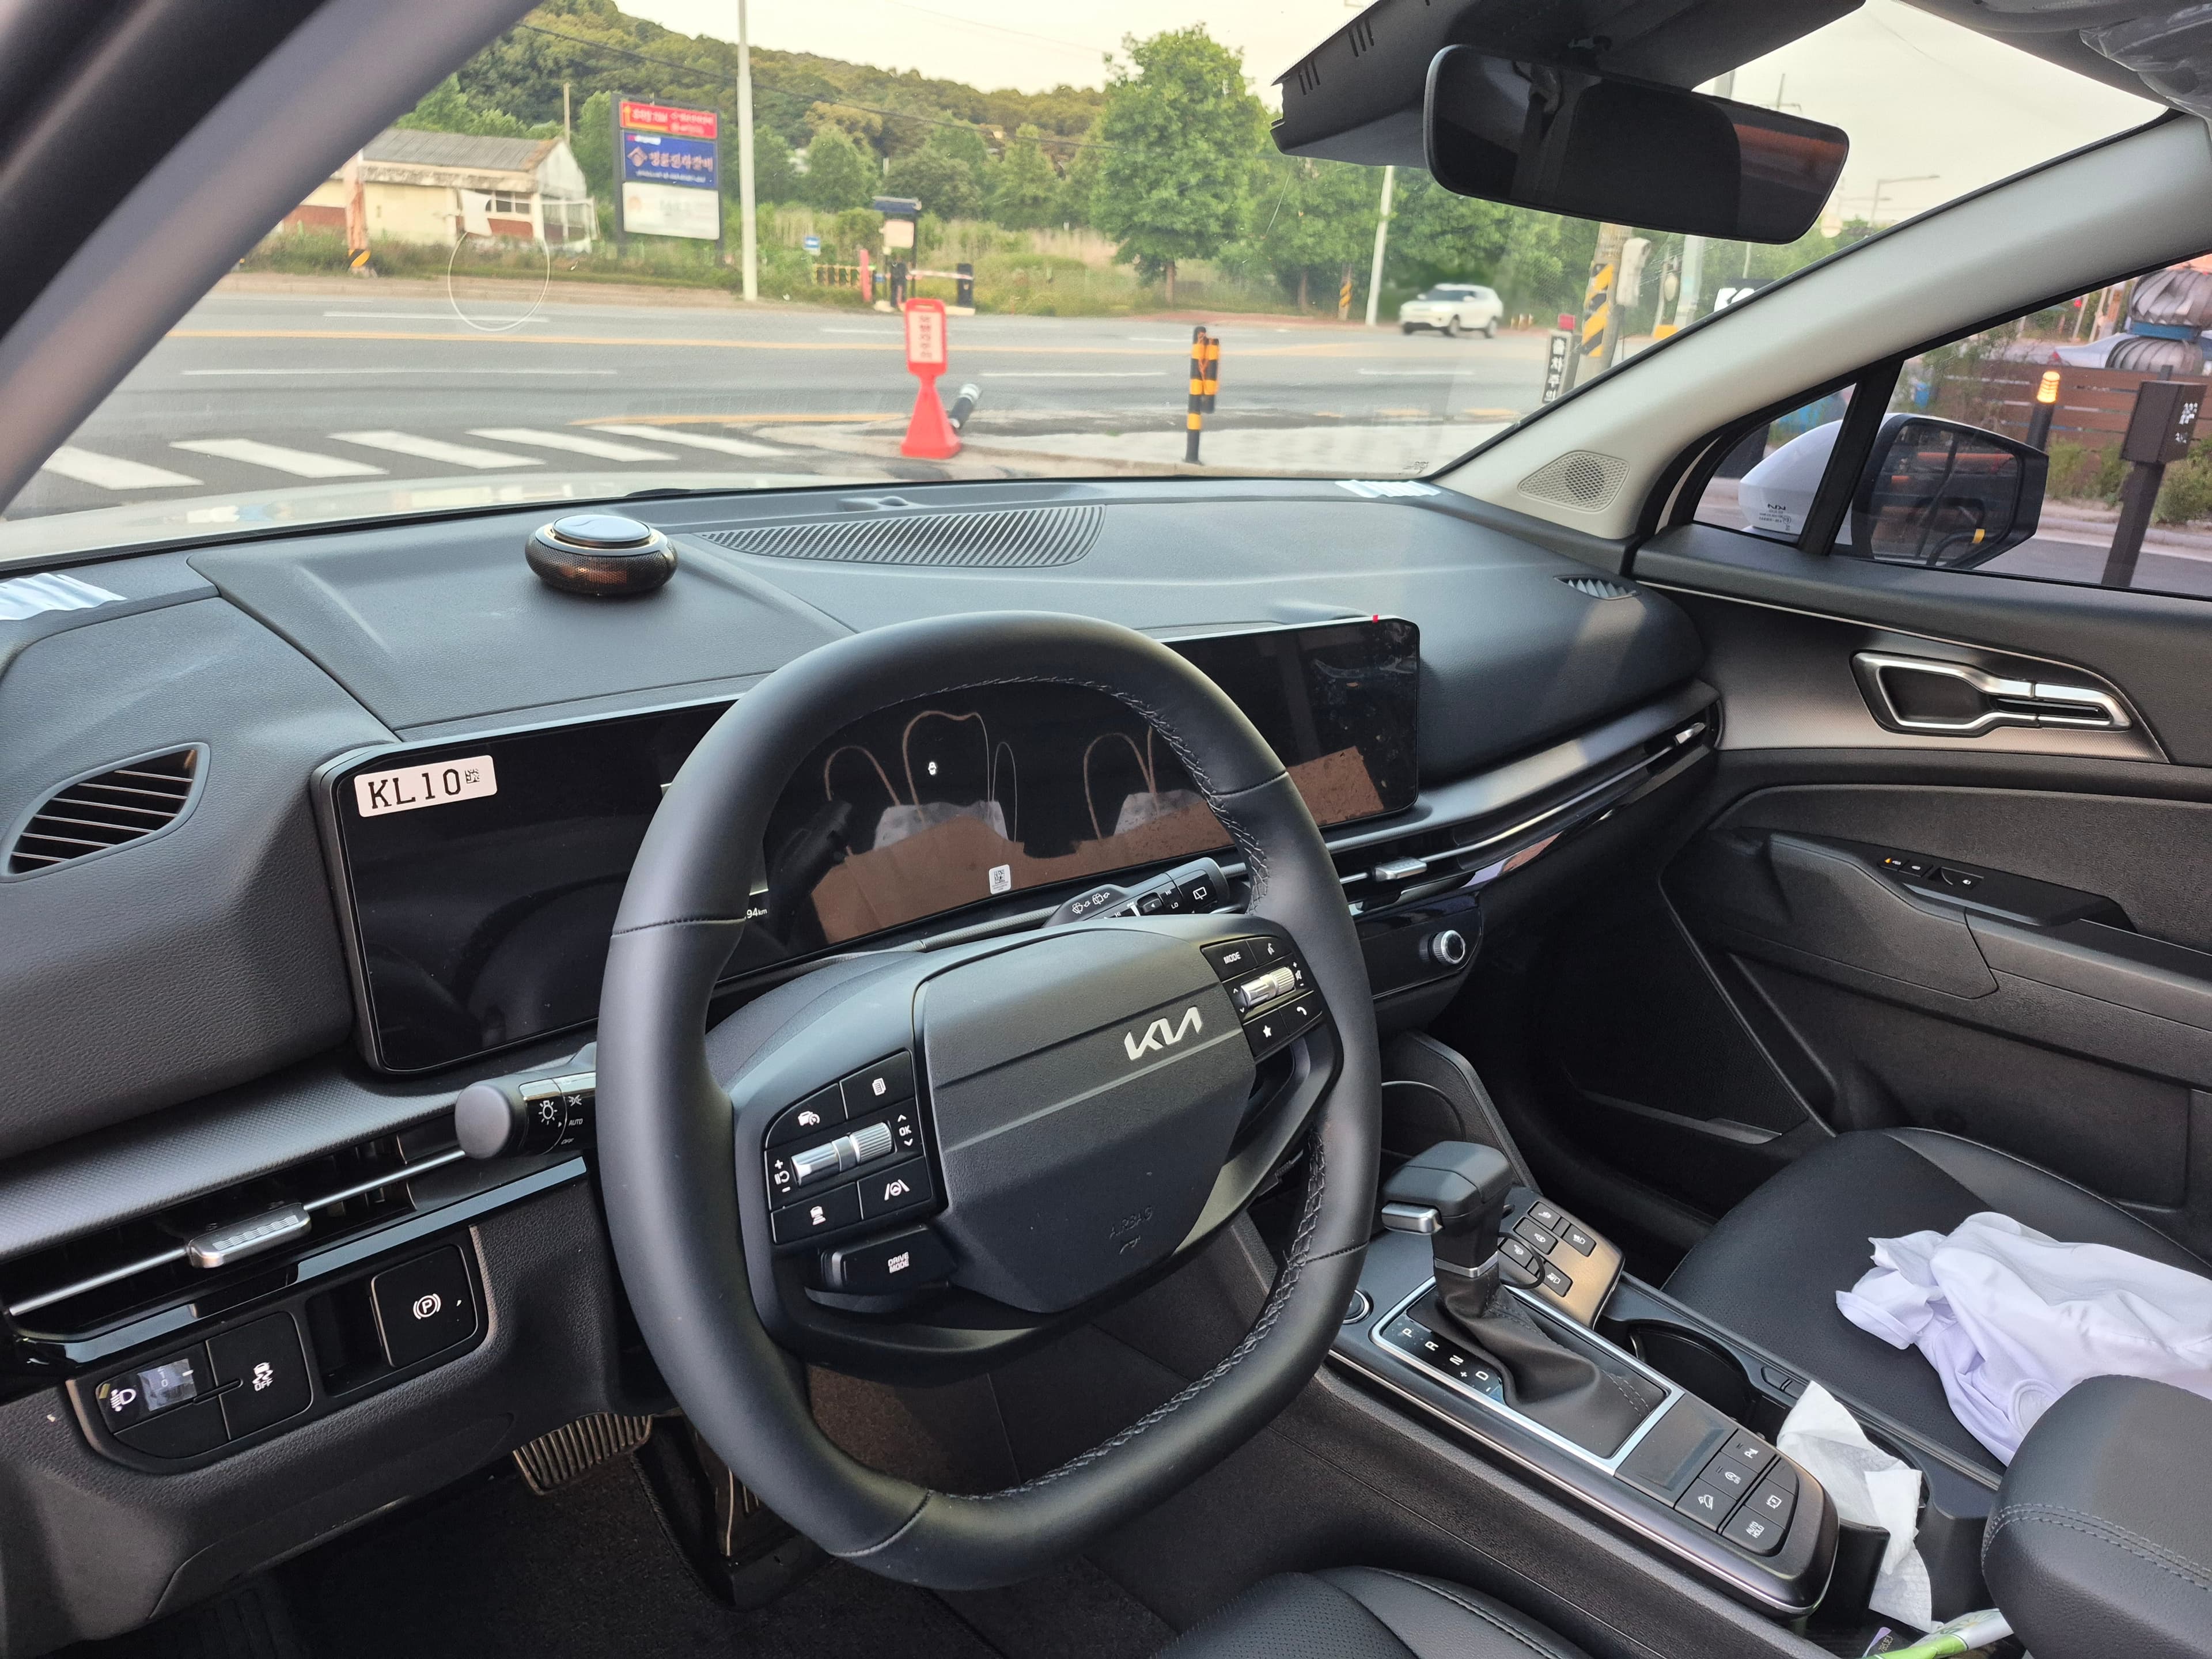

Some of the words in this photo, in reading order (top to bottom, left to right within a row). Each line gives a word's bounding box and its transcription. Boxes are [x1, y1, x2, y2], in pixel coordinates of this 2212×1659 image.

[368, 768, 461, 809] KL10
[1224, 952, 1241, 964] MODE
[1124, 1006, 1203, 1060] KIA
[569, 1118, 583, 1126] AUTO
[899, 1125, 912, 1136] OK
[888, 1251, 909, 1267] DRIVE
[889, 1259, 910, 1274] MODE
[1402, 1328, 1412, 1338] P
[1425, 1341, 1439, 1351] R
[1449, 1355, 1464, 1366] N
[1475, 1370, 1489, 1381] D
[254, 1377, 273, 1392] OFF
[1746, 1521, 1759, 1535] AUTO
[1751, 1525, 1764, 1539] HOLD
